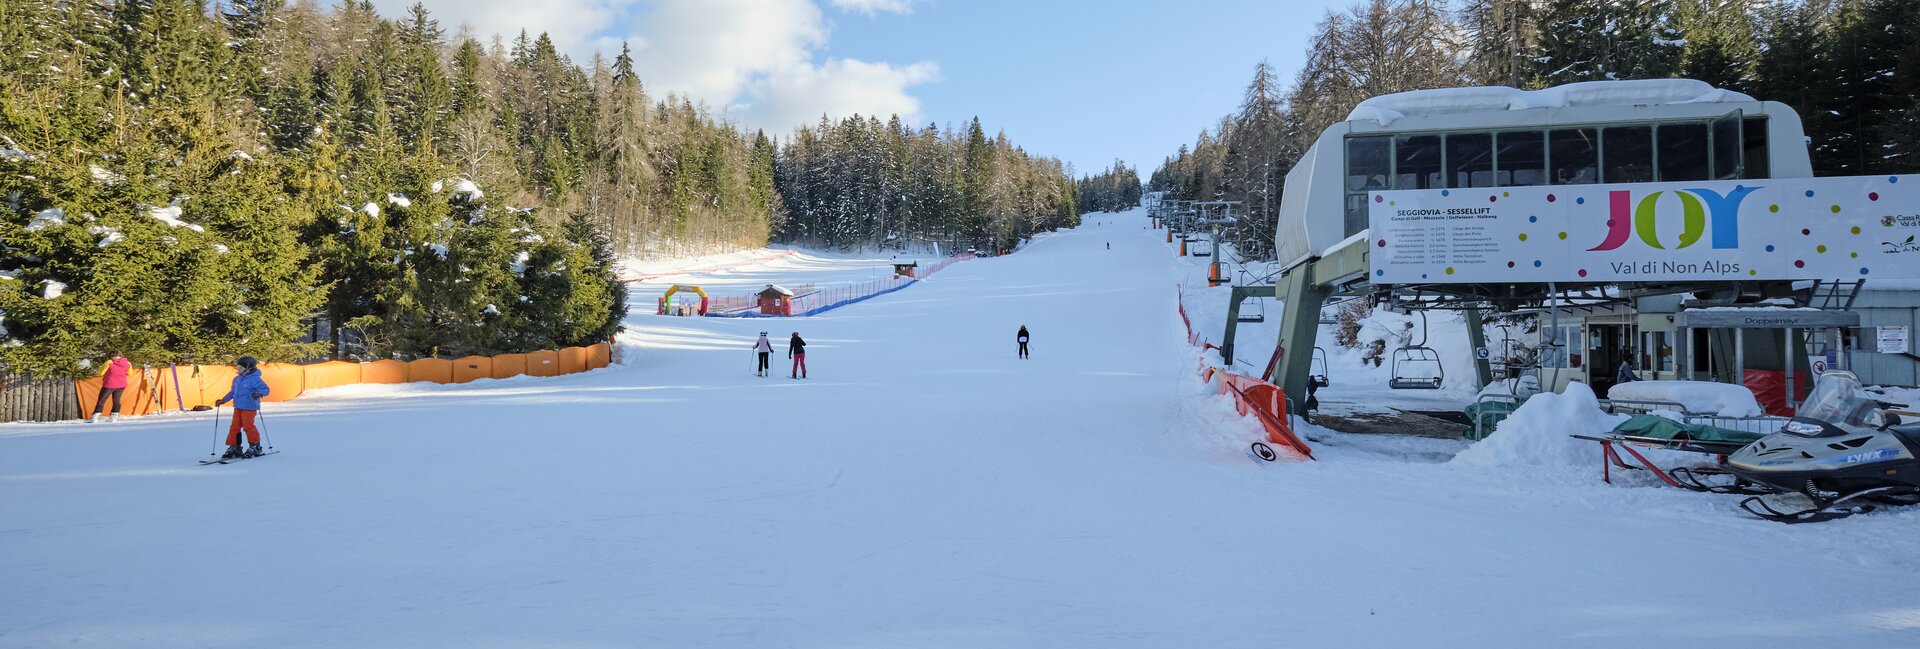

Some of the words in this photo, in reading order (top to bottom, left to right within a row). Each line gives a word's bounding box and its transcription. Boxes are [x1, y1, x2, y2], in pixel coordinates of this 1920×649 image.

[1585, 186, 1765, 251] JOY
[1611, 262, 1636, 274] Val
[1642, 261, 1656, 274] di
[1663, 261, 1697, 274] Non
[1702, 260, 1740, 275] Alps
[1848, 450, 1882, 463] LYNX
